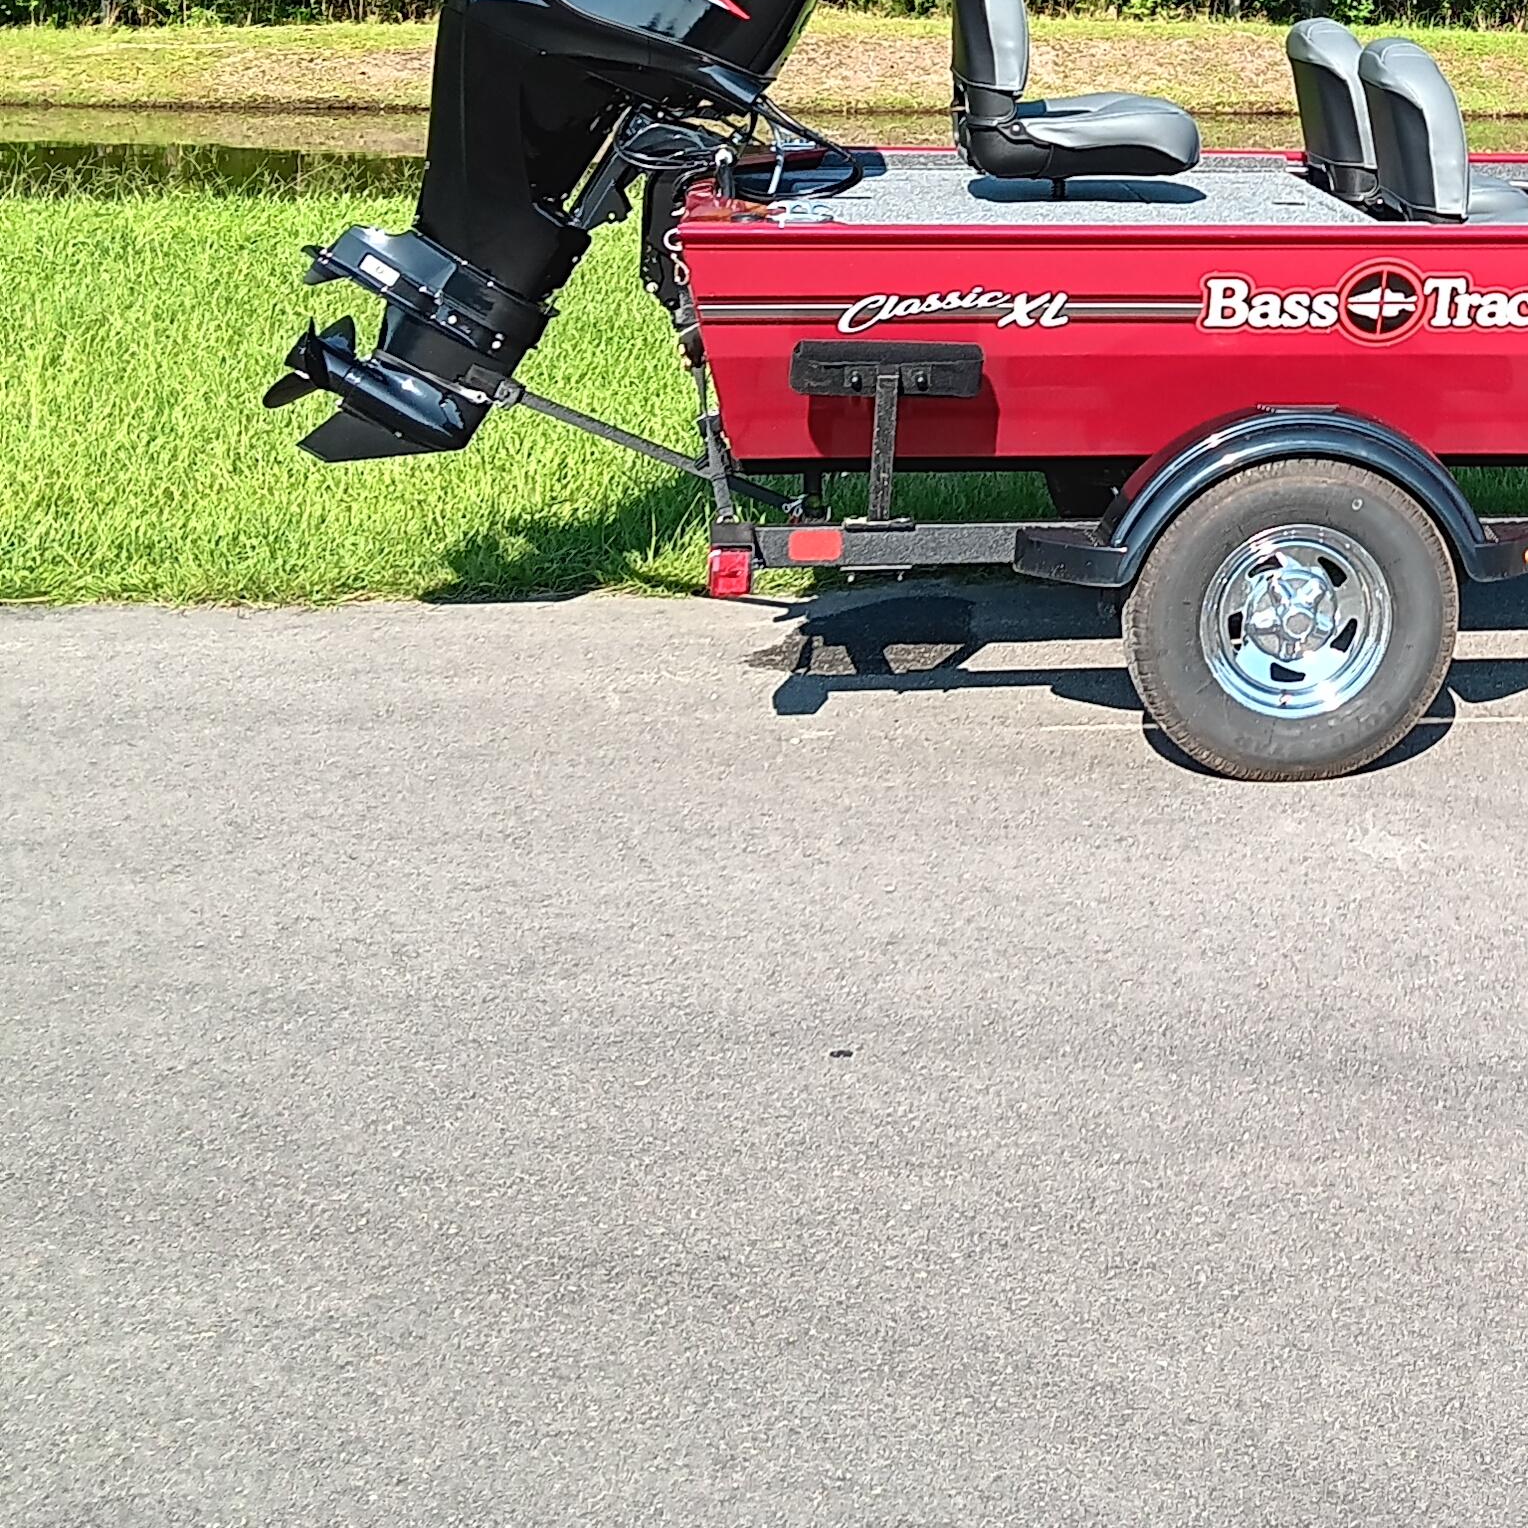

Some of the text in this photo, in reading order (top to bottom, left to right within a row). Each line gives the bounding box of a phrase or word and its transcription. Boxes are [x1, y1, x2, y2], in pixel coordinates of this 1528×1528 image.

[837, 286, 1069, 333] Classic XL
[1203, 277, 1339, 329] Bass
